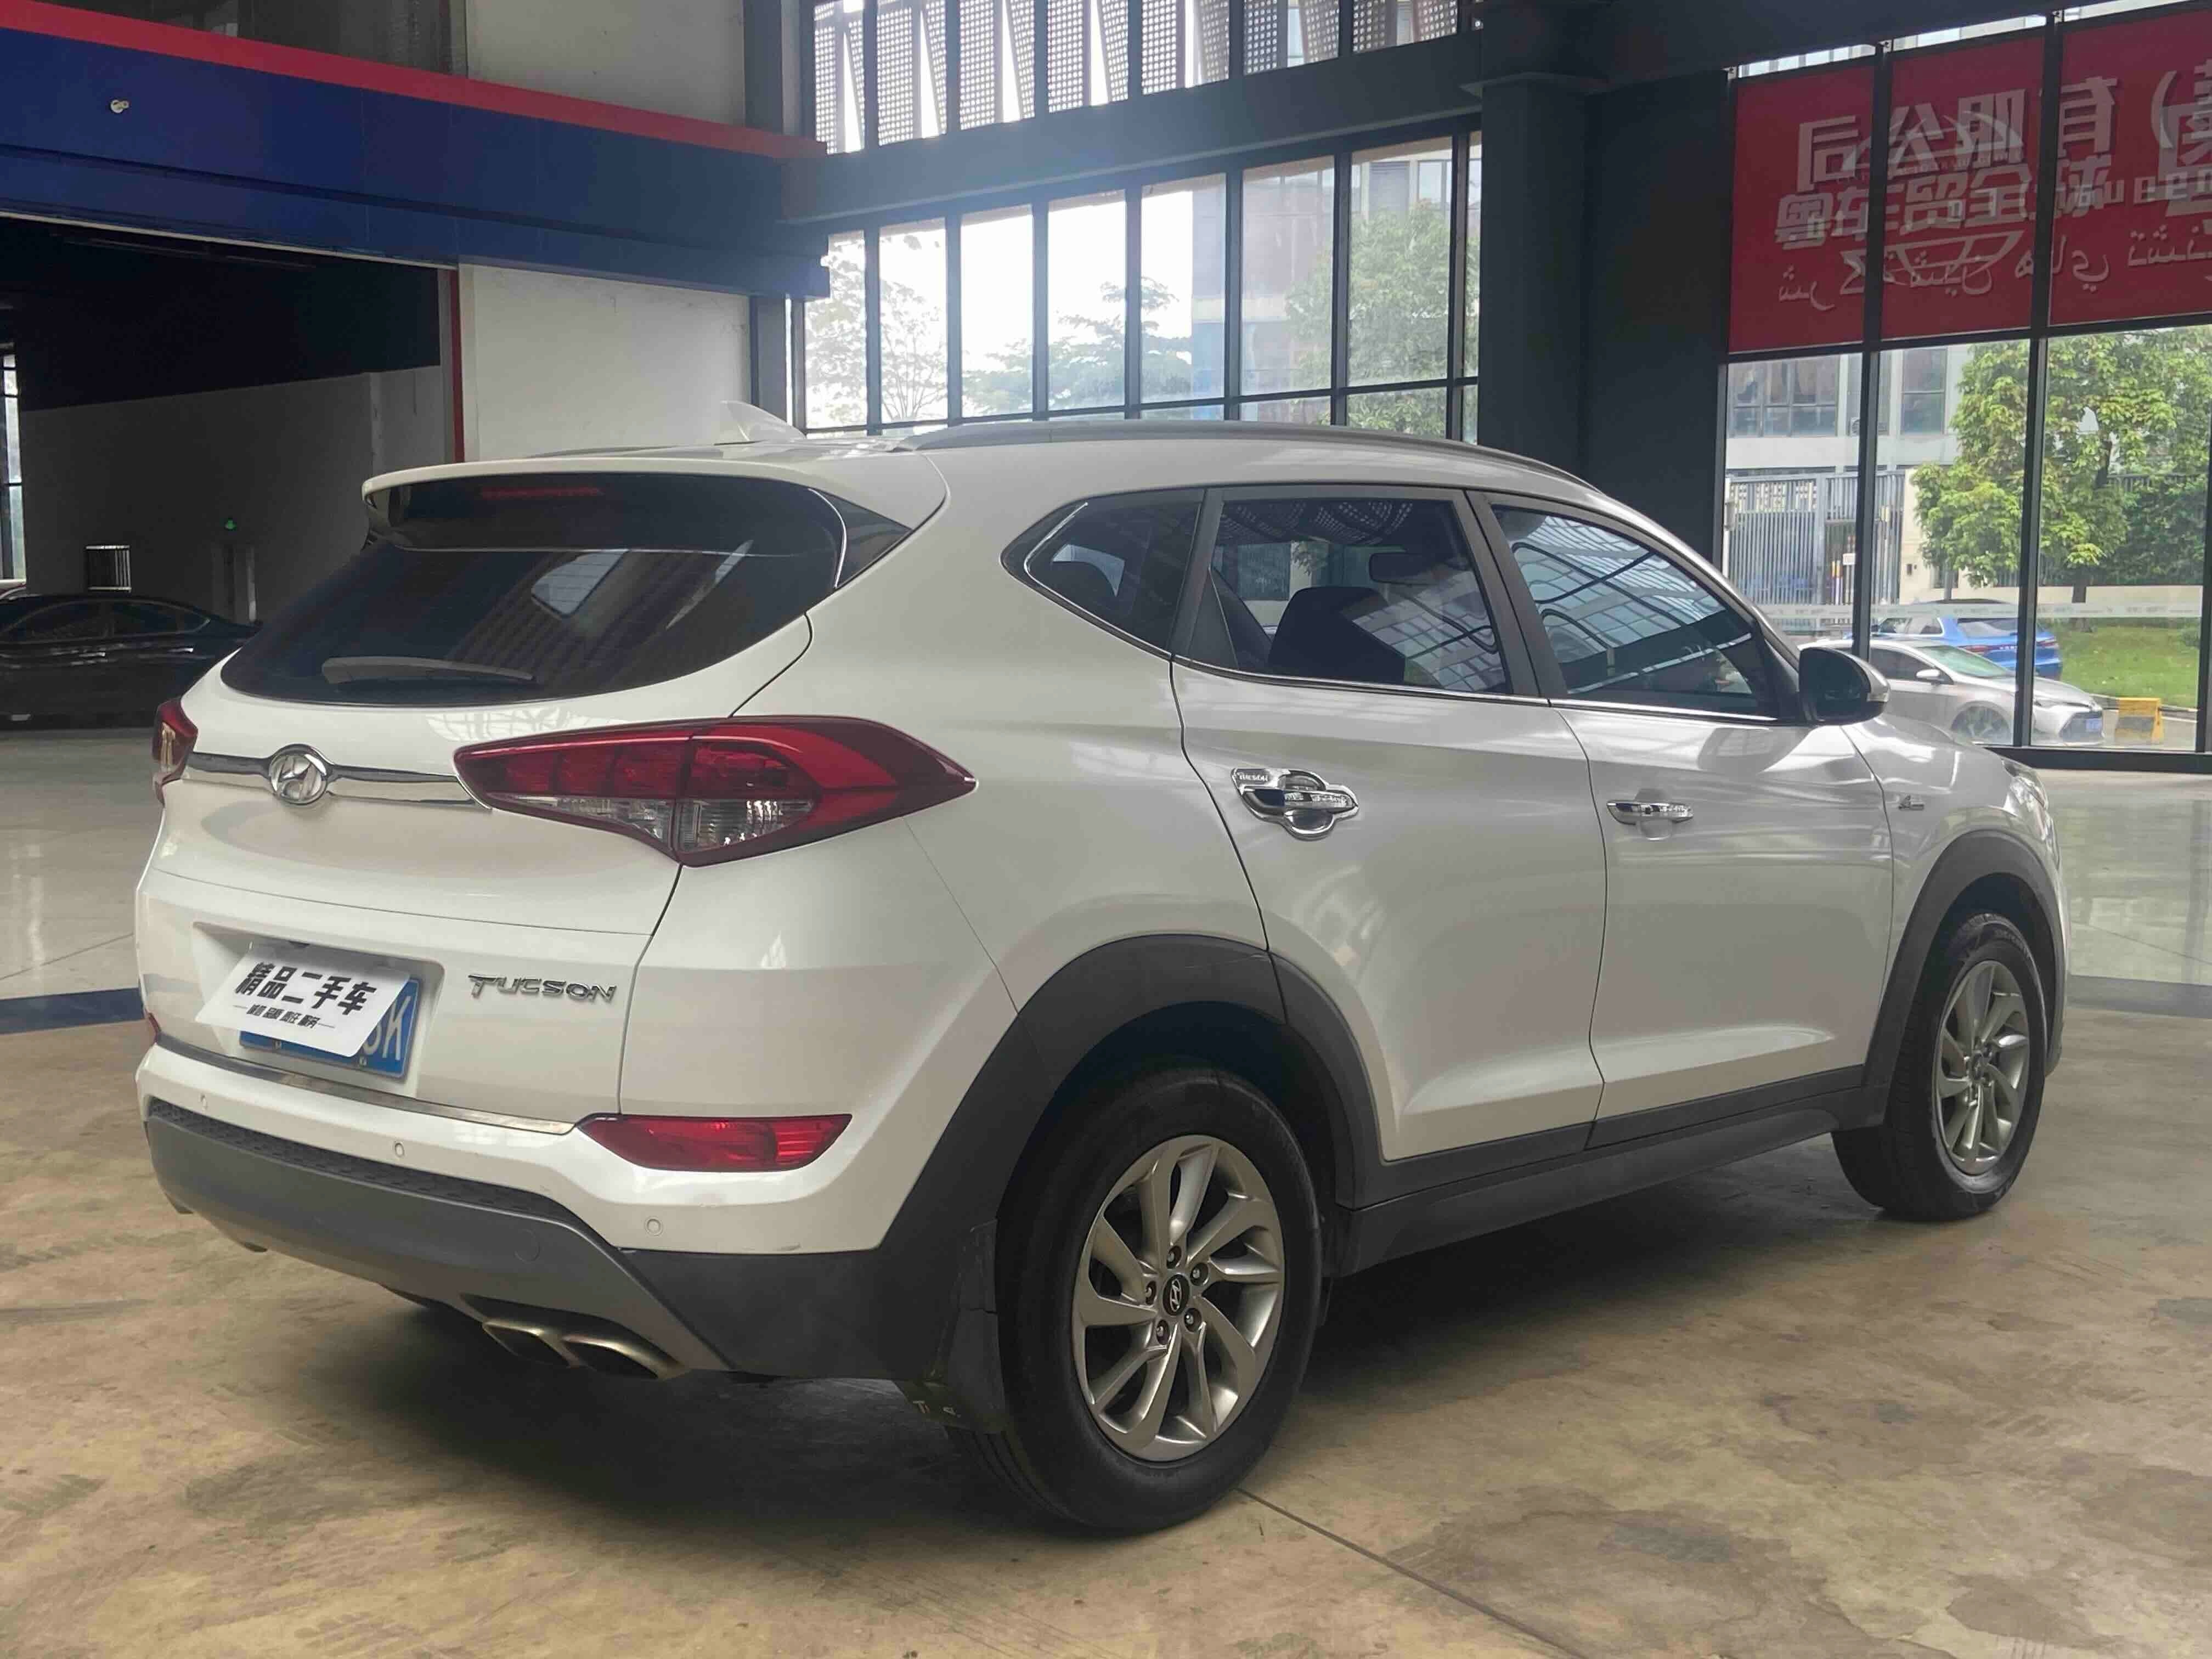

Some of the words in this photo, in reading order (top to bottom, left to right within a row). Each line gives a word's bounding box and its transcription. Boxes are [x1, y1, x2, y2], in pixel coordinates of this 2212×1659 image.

[234, 961, 377, 1015] 精品二手车
[467, 974, 617, 1003] TUCSON
